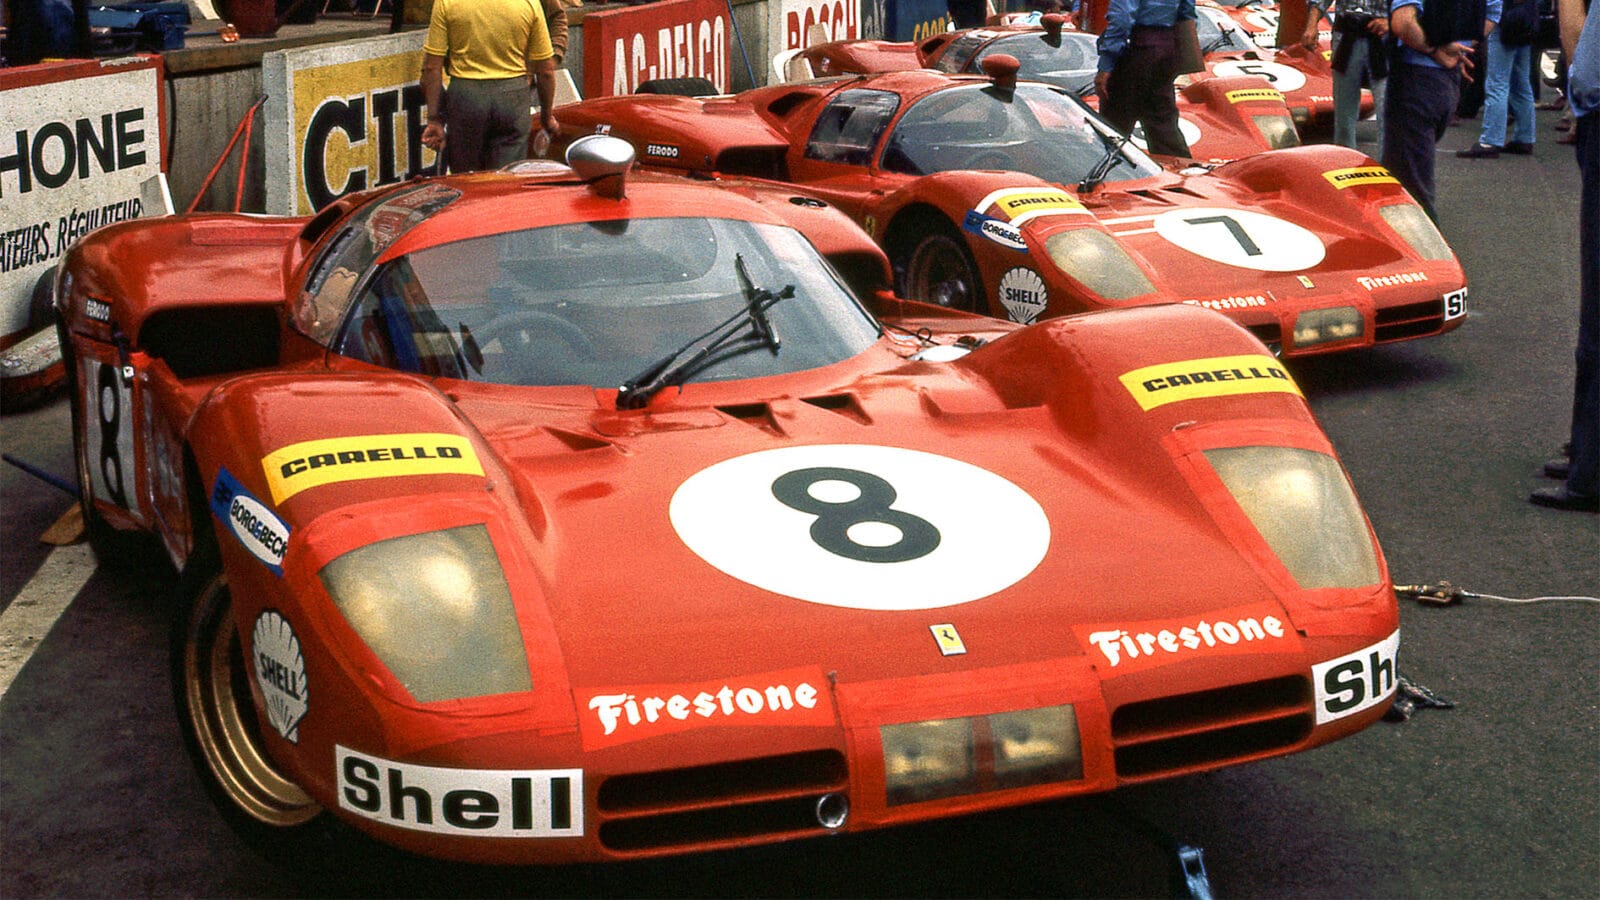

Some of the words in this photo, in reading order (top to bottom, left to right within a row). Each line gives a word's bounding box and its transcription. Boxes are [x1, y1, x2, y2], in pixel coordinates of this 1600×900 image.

[1237, 65, 1277, 82] 5
[0, 108, 146, 197] HONE
[647, 144, 679, 157] FERODO
[56, 197, 144, 257] RÉGULATEUR
[983, 221, 1026, 245] BORG&BEC
[1182, 215, 1264, 256] 7
[1006, 287, 1042, 306] SHELL
[1356, 269, 1429, 291] Firestone
[1142, 366, 1289, 393] CARELLO
[99, 363, 130, 510] 8
[280, 446, 463, 479] CARELLO
[771, 466, 942, 563] 8
[1089, 614, 1285, 668] Firestone
[259, 652, 301, 701] SHELL
[1324, 650, 1399, 714] Sh
[588, 681, 819, 736] Firestone
[343, 755, 571, 830] Shell
